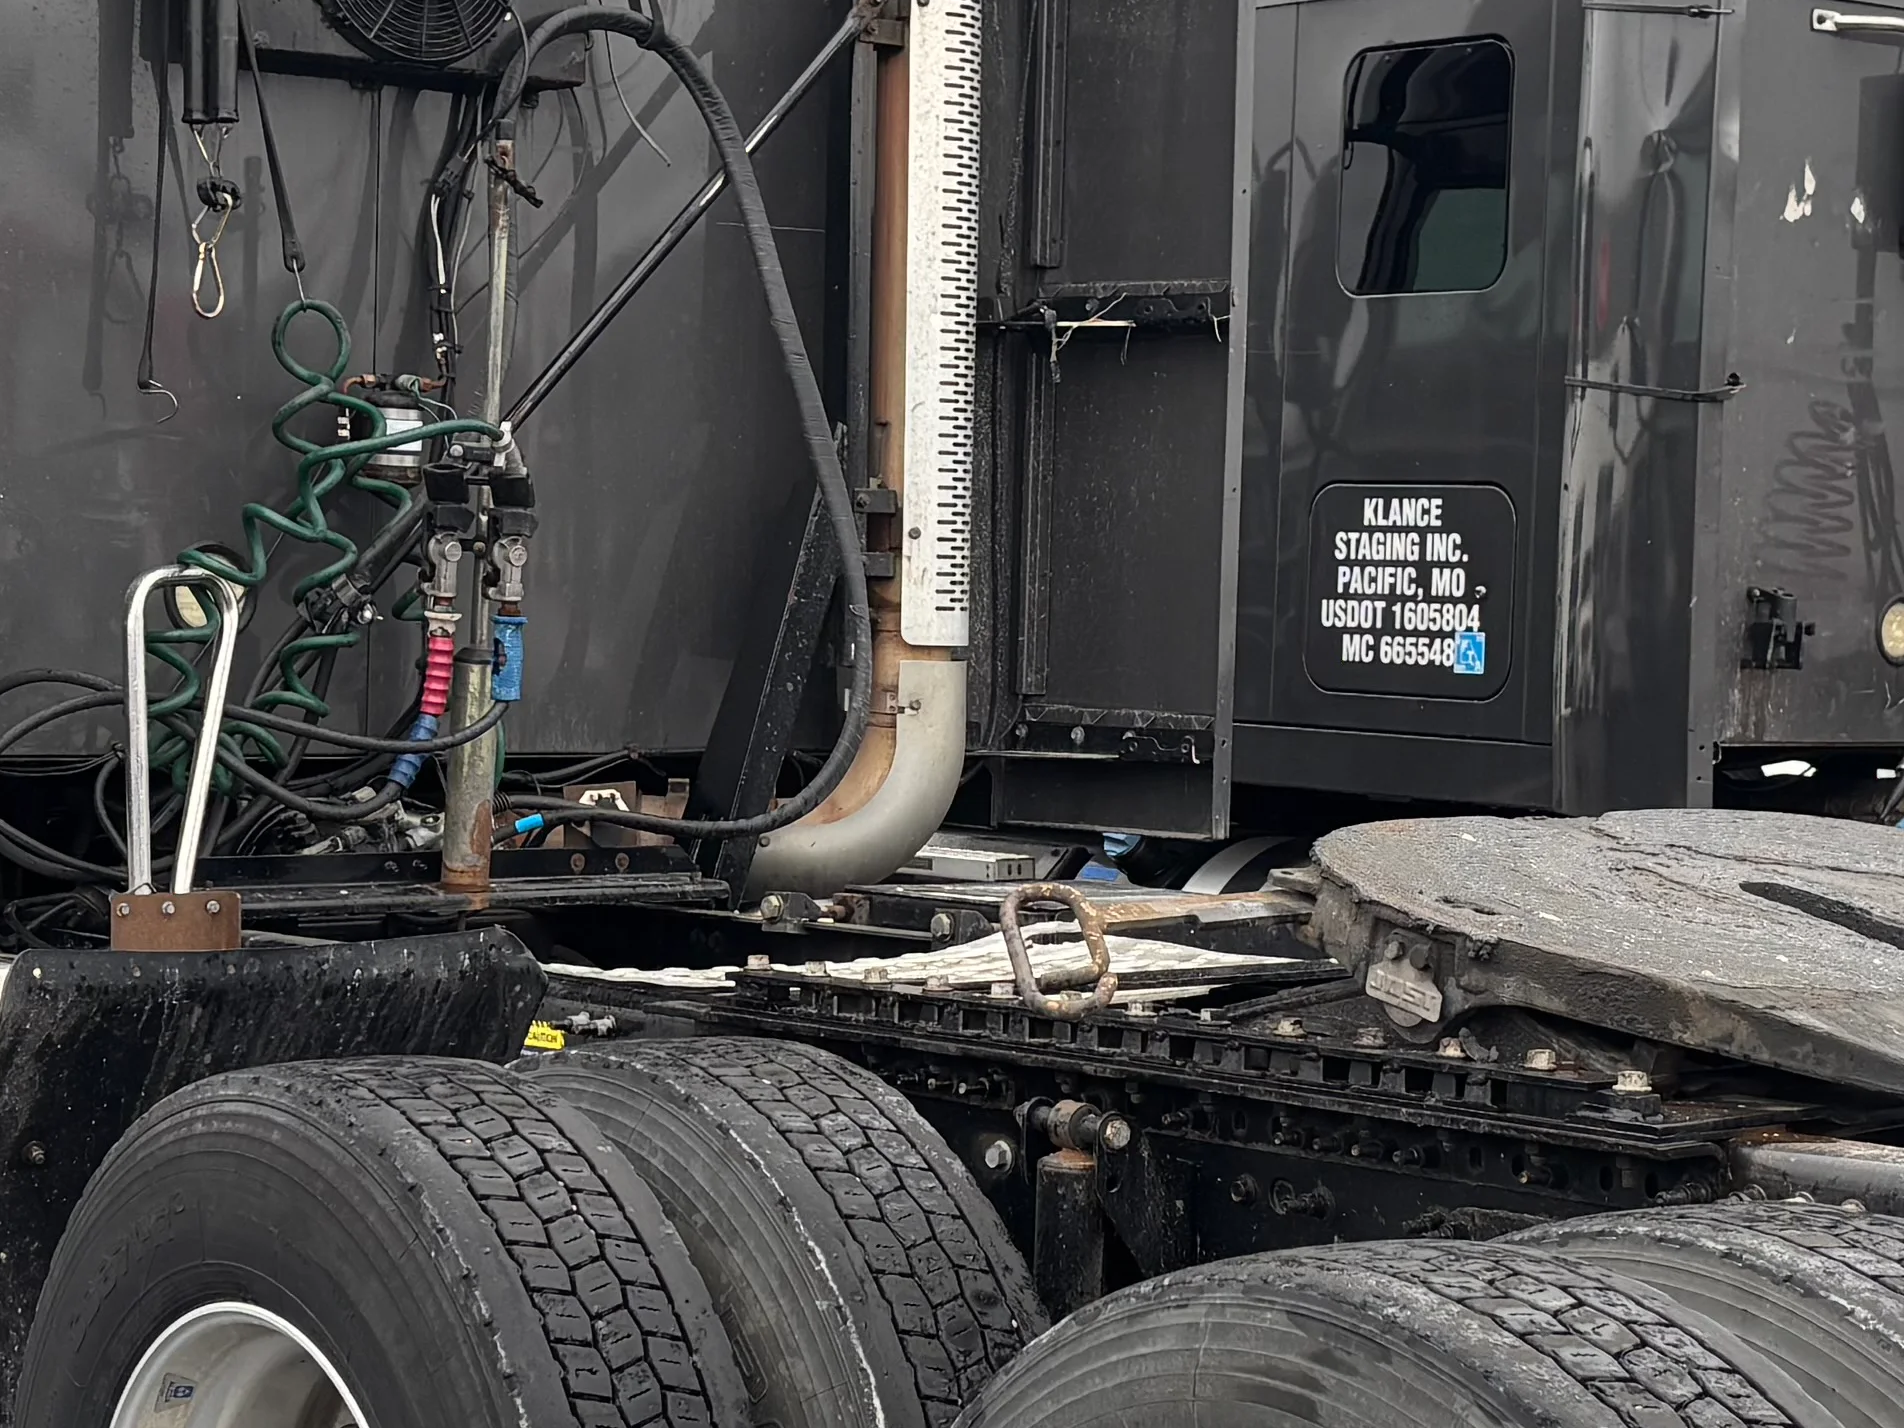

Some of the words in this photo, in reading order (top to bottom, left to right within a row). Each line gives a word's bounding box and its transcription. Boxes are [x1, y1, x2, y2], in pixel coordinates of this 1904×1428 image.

[1363, 498, 1443, 526] KLANCE
[1334, 532, 1419, 561] STAGING
[1426, 533, 1468, 562] INC.
[1337, 566, 1423, 600] PACIFIC,
[1431, 568, 1465, 597] MO
[1321, 599, 1386, 628] USDOT
[1392, 602, 1480, 632] 1605804
[1342, 634, 1374, 662] MC
[1380, 636, 1455, 666] 665548
